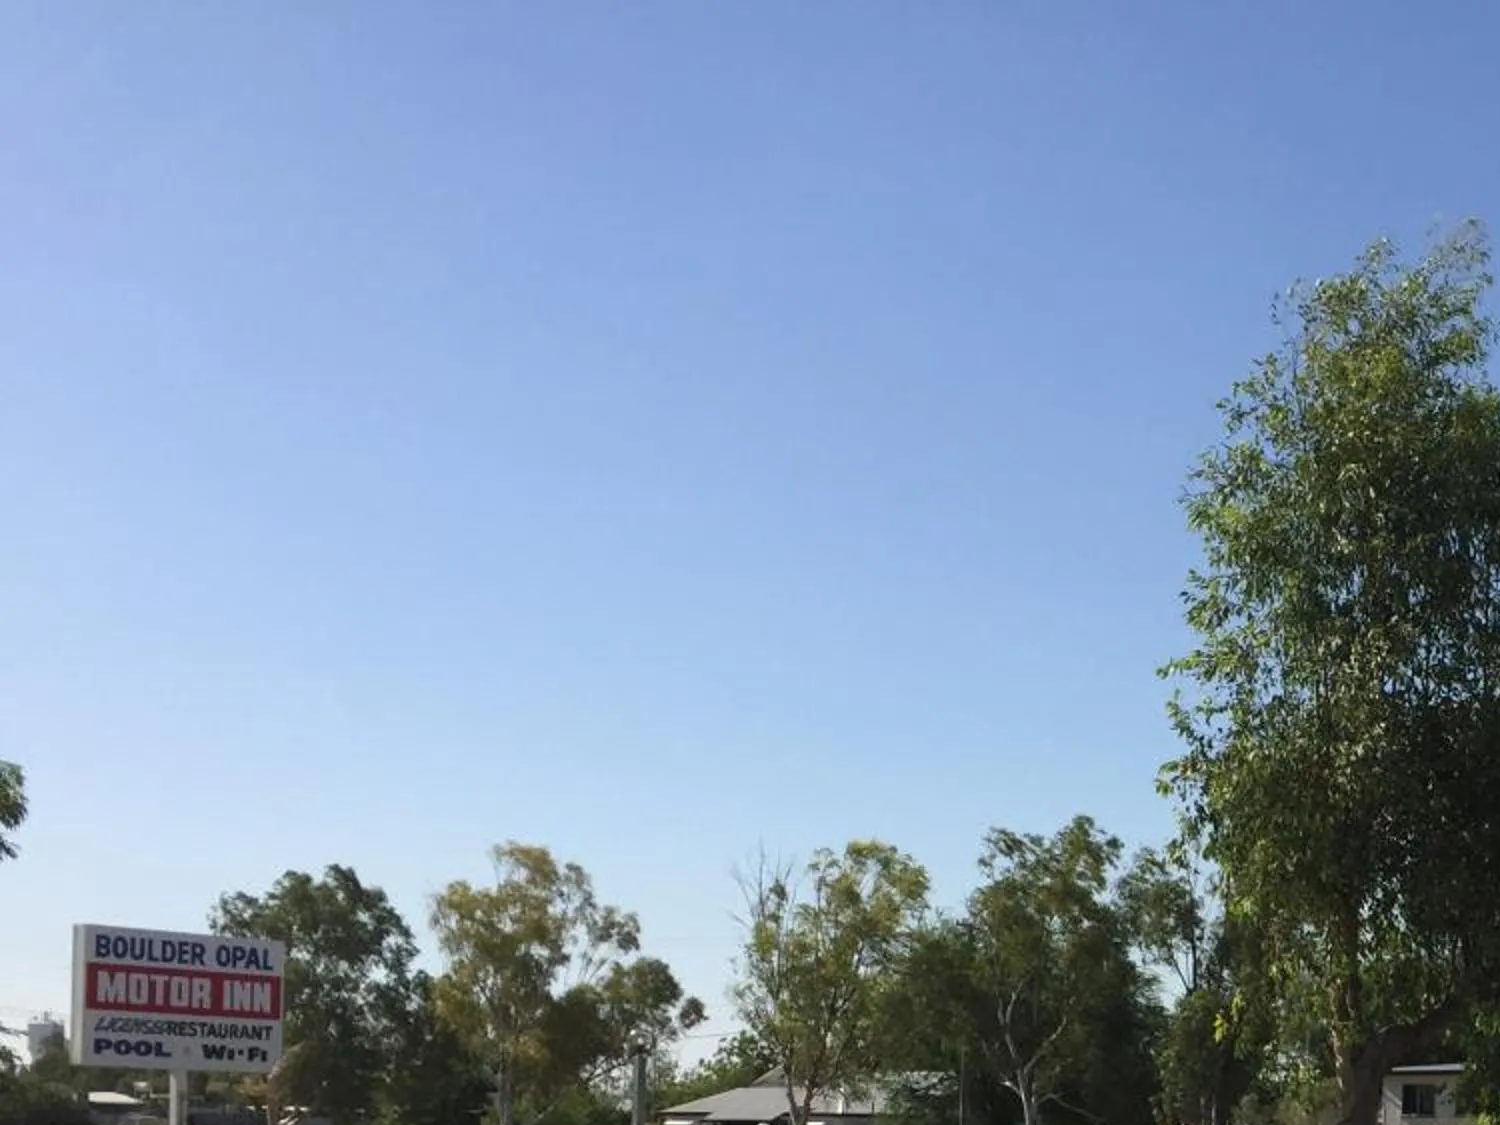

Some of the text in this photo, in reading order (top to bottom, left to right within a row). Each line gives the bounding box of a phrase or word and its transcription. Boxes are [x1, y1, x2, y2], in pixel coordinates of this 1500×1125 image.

[95, 934, 274, 971] BOULDER OPAL
[96, 970, 272, 1013] MOTOR INN
[167, 1021, 273, 1041] RESTAURANT
[93, 1038, 172, 1058] POOL
